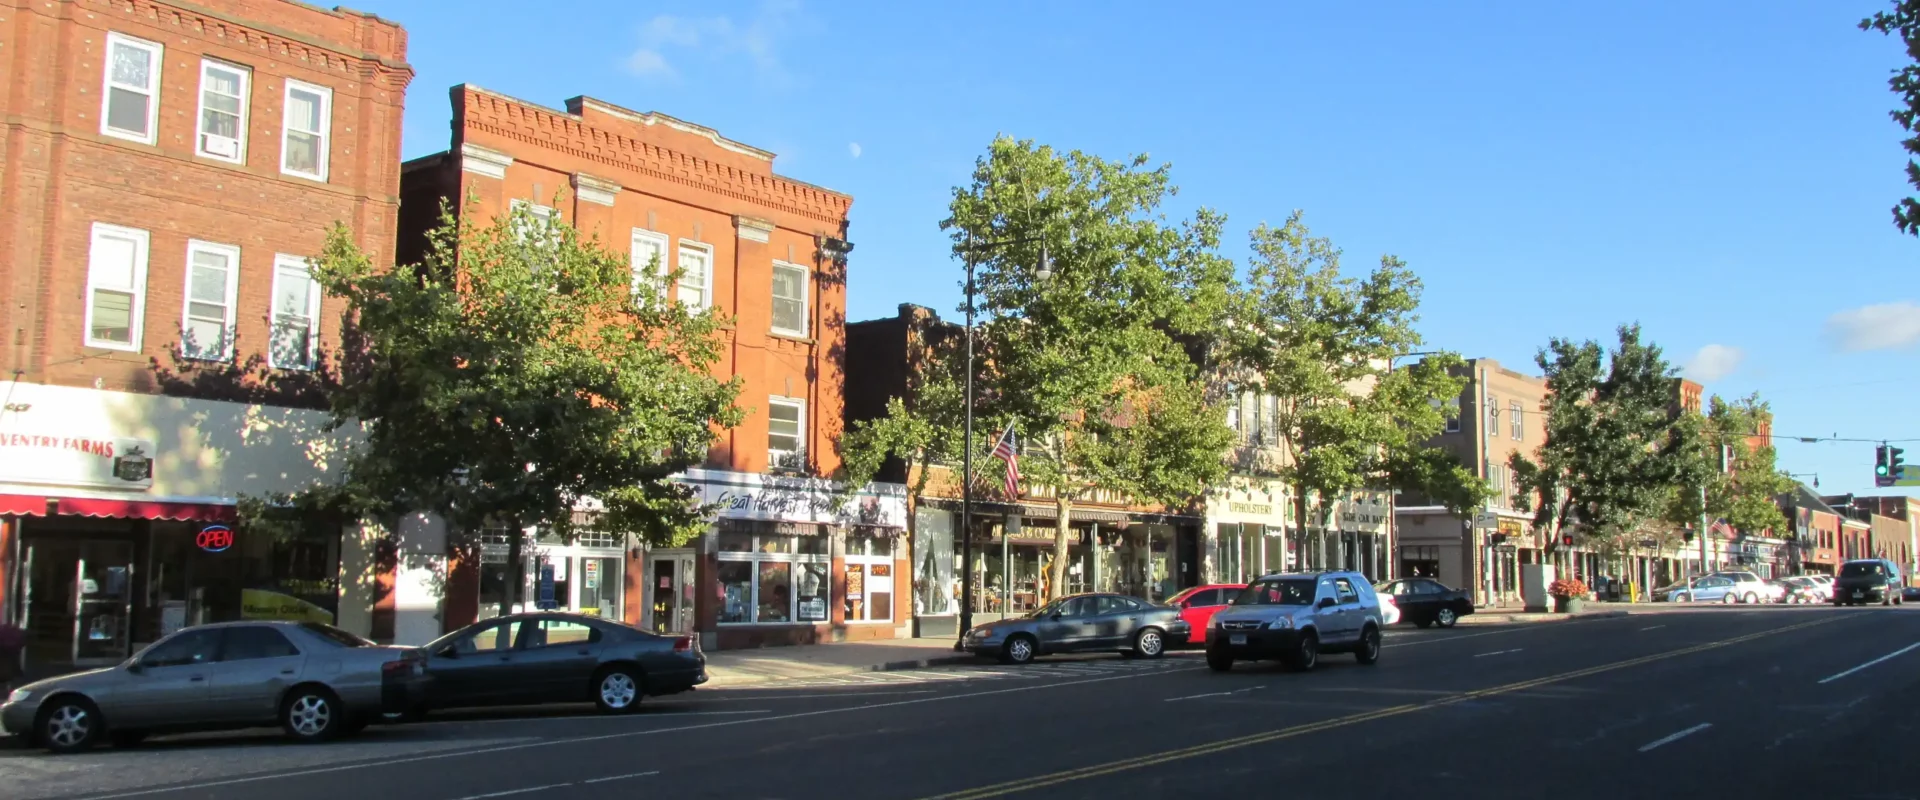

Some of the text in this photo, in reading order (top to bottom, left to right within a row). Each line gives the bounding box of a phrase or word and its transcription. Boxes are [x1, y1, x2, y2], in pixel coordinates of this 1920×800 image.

[63, 438, 114, 458] FARMS
[716, 490, 752, 511] Great
[1229, 503, 1273, 516] UPHOLSTERY
[195, 530, 234, 548] OPEN
